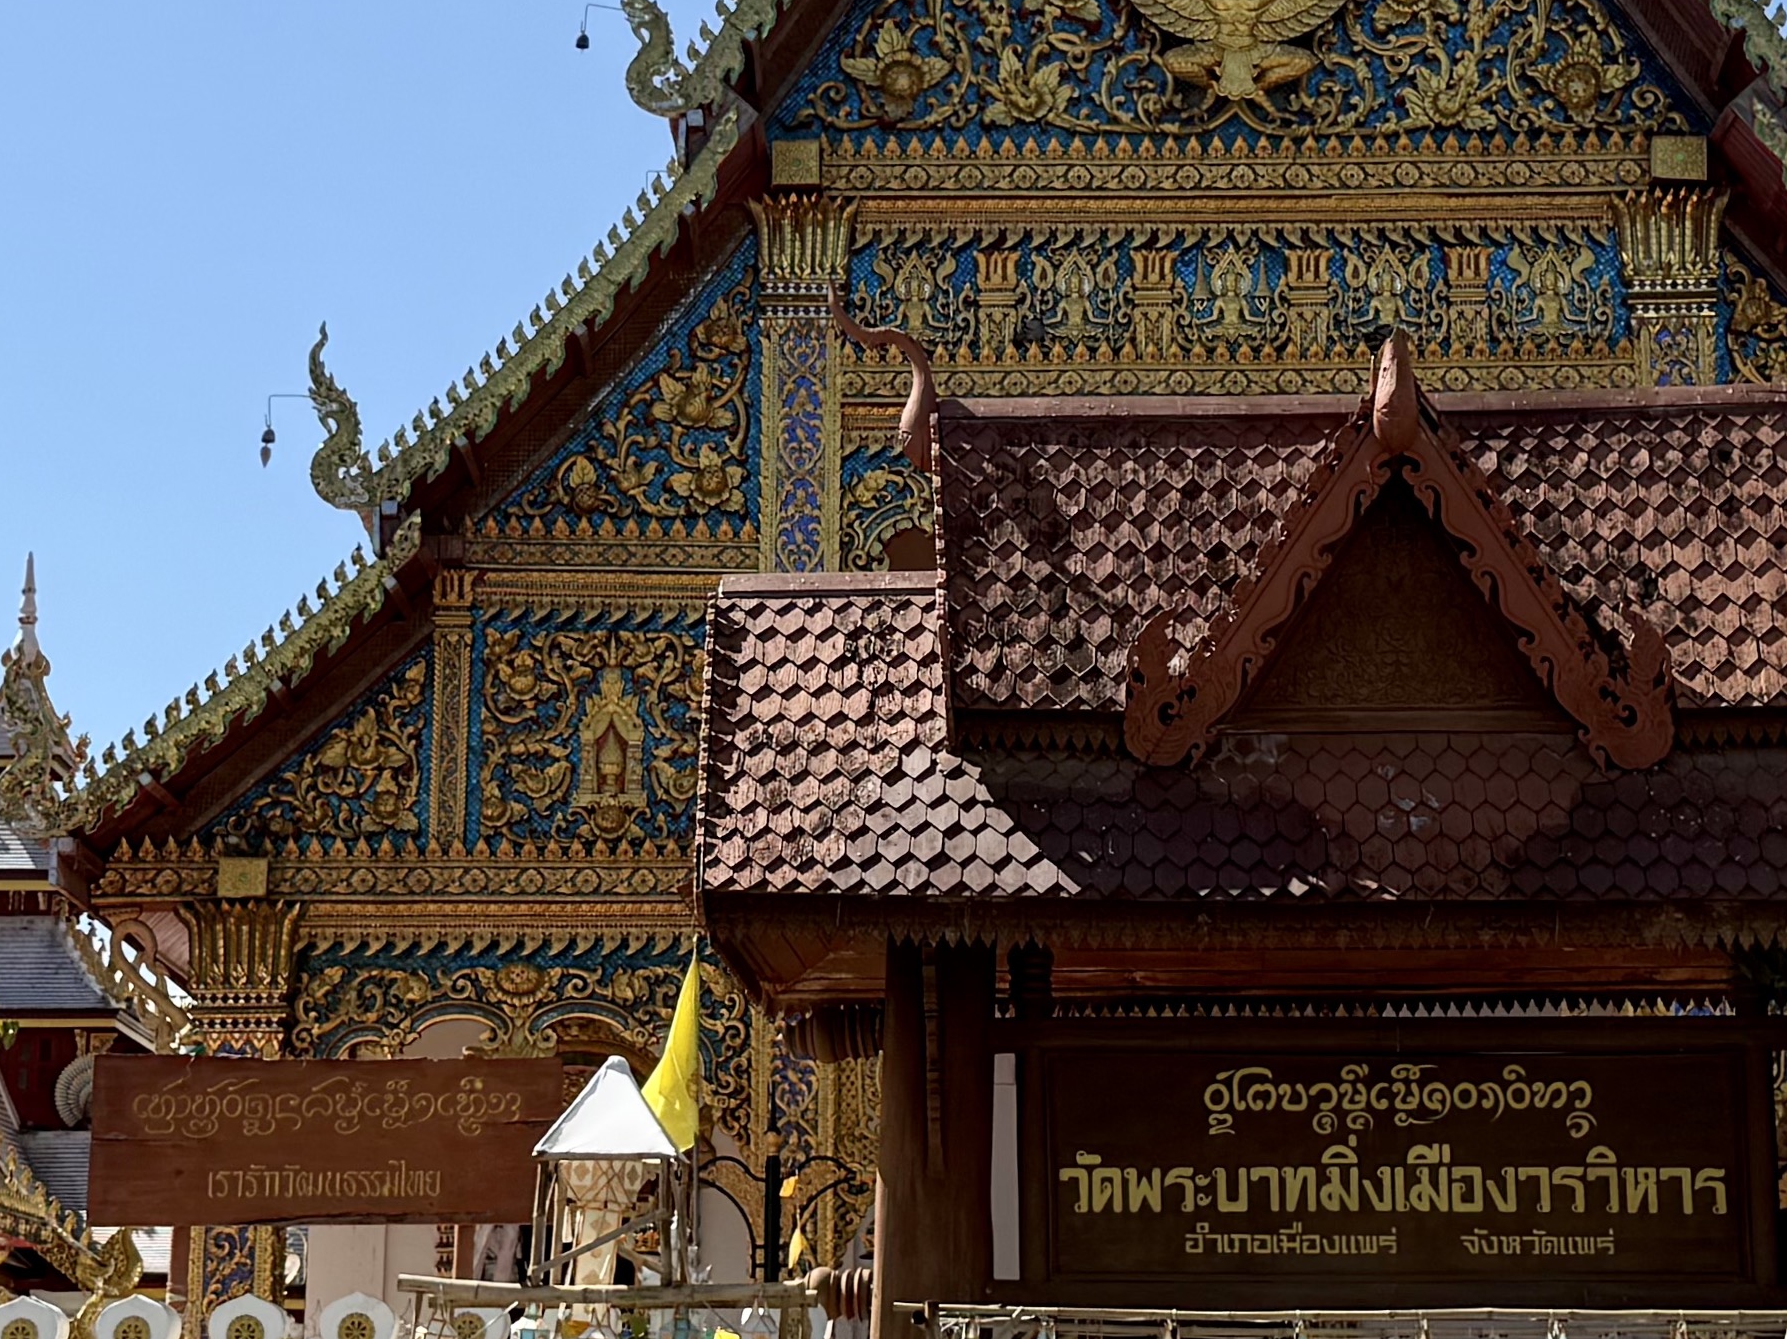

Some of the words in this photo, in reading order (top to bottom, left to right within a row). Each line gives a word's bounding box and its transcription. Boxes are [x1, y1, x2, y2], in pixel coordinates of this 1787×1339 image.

[1059, 1135, 1728, 1215] วัดพระบาทมิ่งเมืองวรวิหาร
[1185, 1222, 1398, 1257] อำเภอเมืองแพร่
[1461, 1228, 1616, 1257] จังหวัดแพร่
